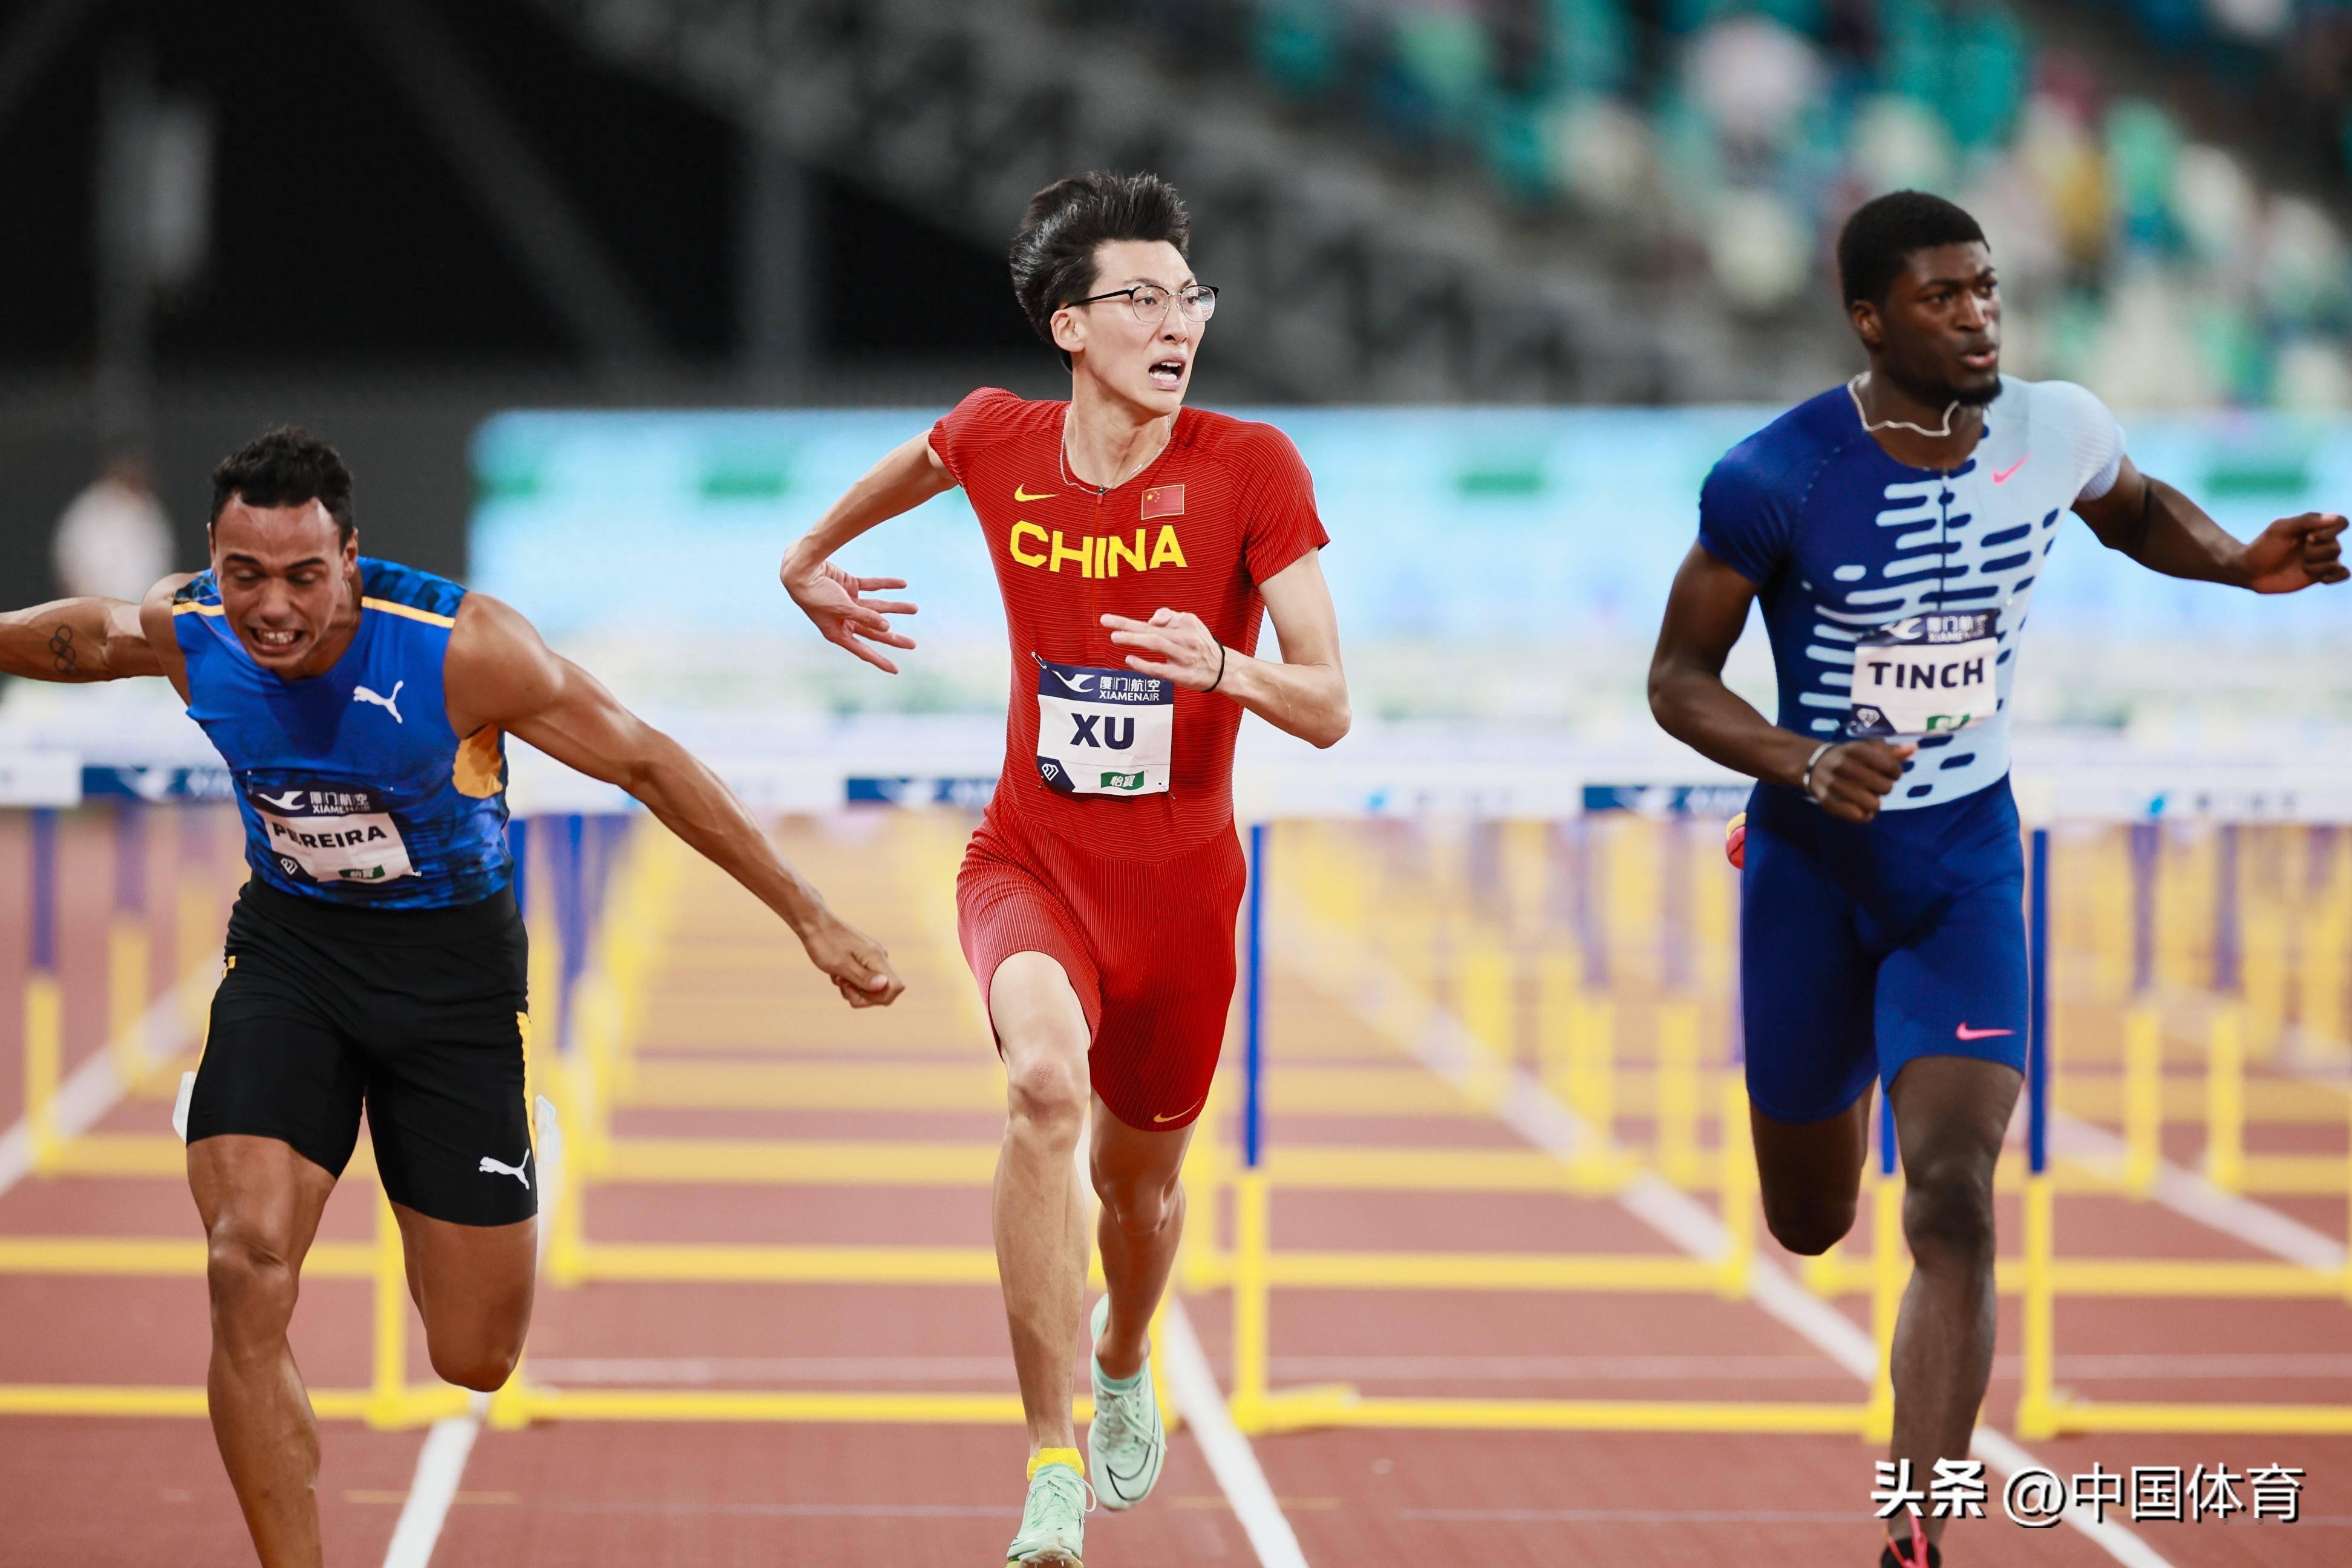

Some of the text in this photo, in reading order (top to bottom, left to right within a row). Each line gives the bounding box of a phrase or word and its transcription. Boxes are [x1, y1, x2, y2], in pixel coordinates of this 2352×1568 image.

[1009, 520, 1188, 579] CHINA
[1099, 676, 1160, 692] 厦门航空
[1867, 657, 1984, 689] TINCH
[1099, 690, 1159, 702] XIAMENAIR
[1070, 713, 1134, 750] XU
[272, 822, 387, 848] PEREIRA
